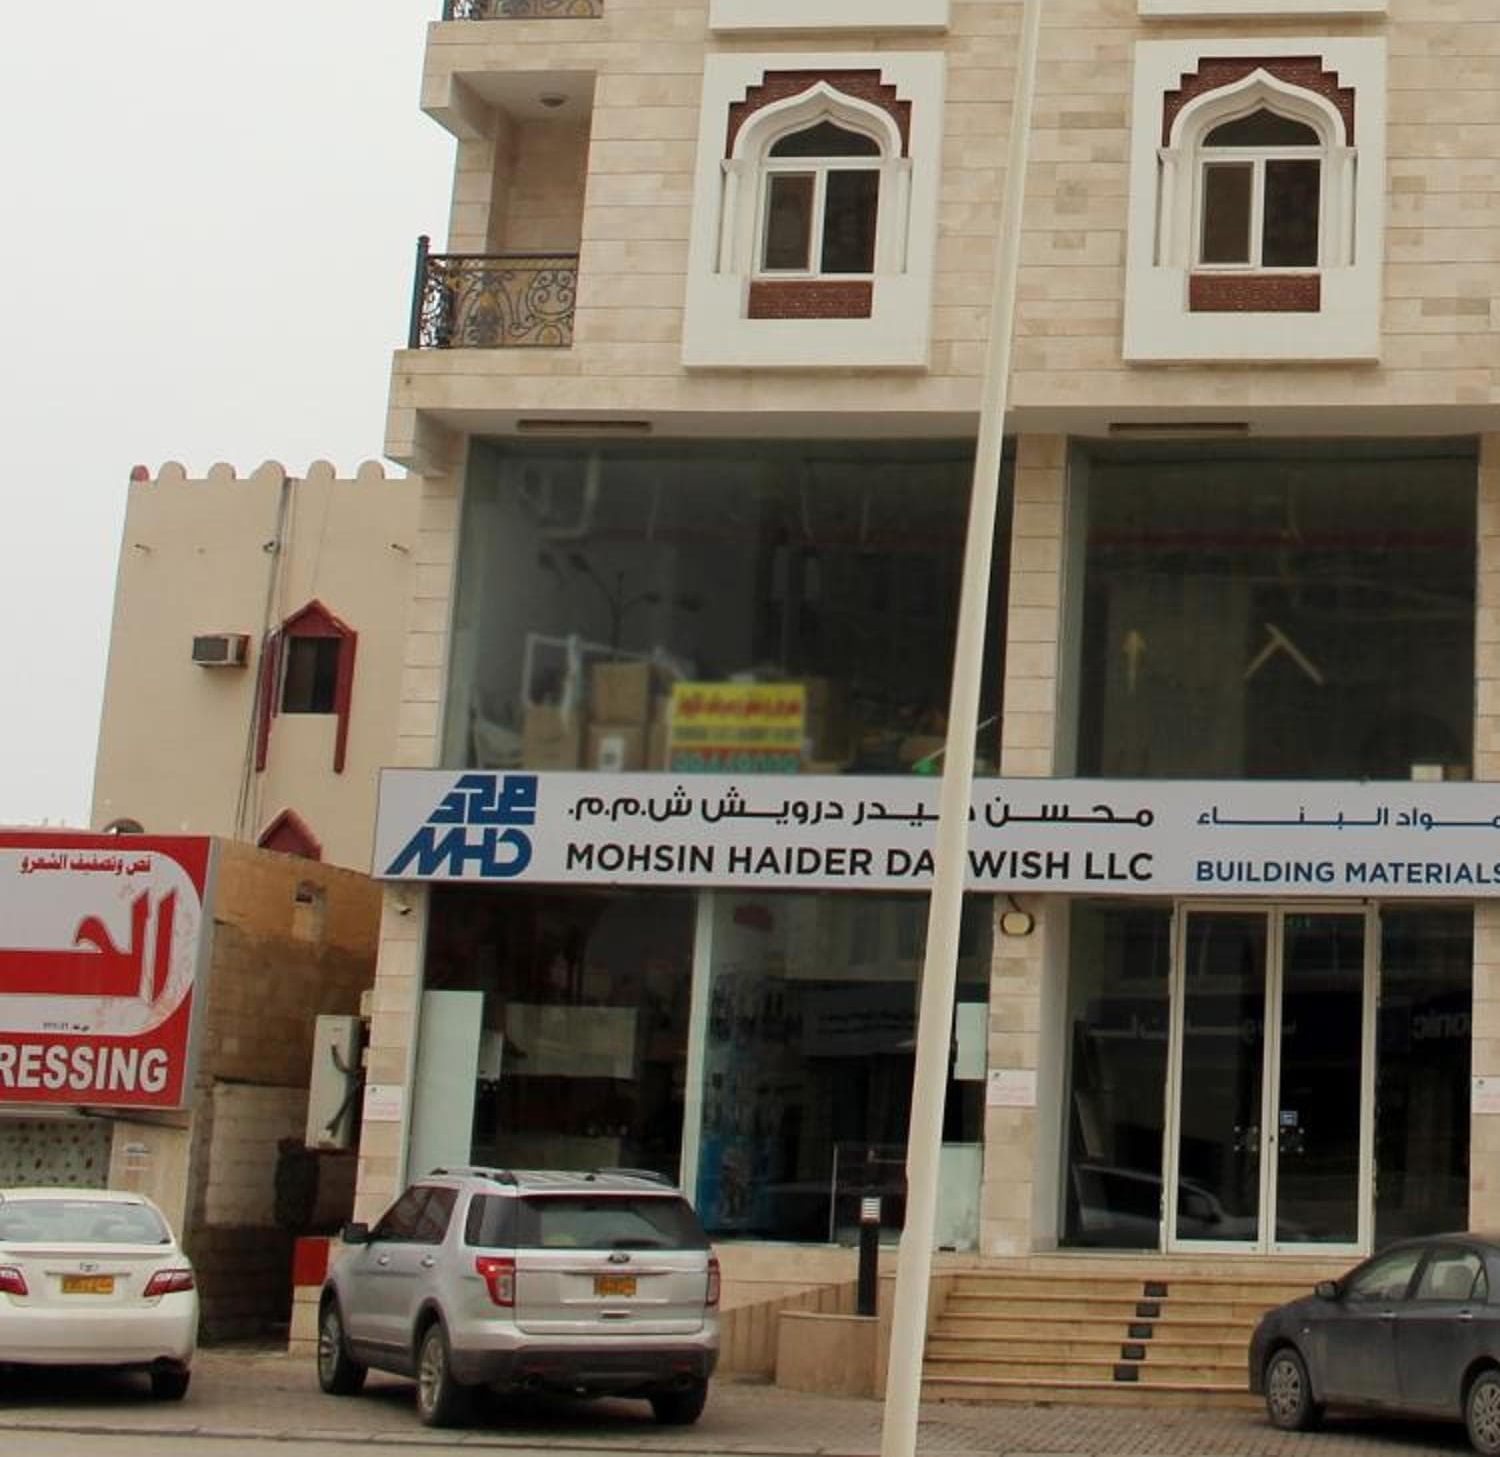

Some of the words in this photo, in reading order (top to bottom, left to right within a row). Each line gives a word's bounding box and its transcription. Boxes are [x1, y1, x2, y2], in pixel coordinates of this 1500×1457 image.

[701, 786, 844, 824] درويش
[853, 802, 975, 827] يدر
[985, 796, 1154, 827] محسن
[1197, 807, 1388, 829] البناء
[384, 827, 532, 877] MHD
[567, 843, 714, 872] MOHSIN
[728, 846, 872, 875] HAIDER
[886, 848, 1070, 879] DAWISH
[1085, 852, 1153, 880] LLC
[1196, 861, 1335, 883] BUILDING
